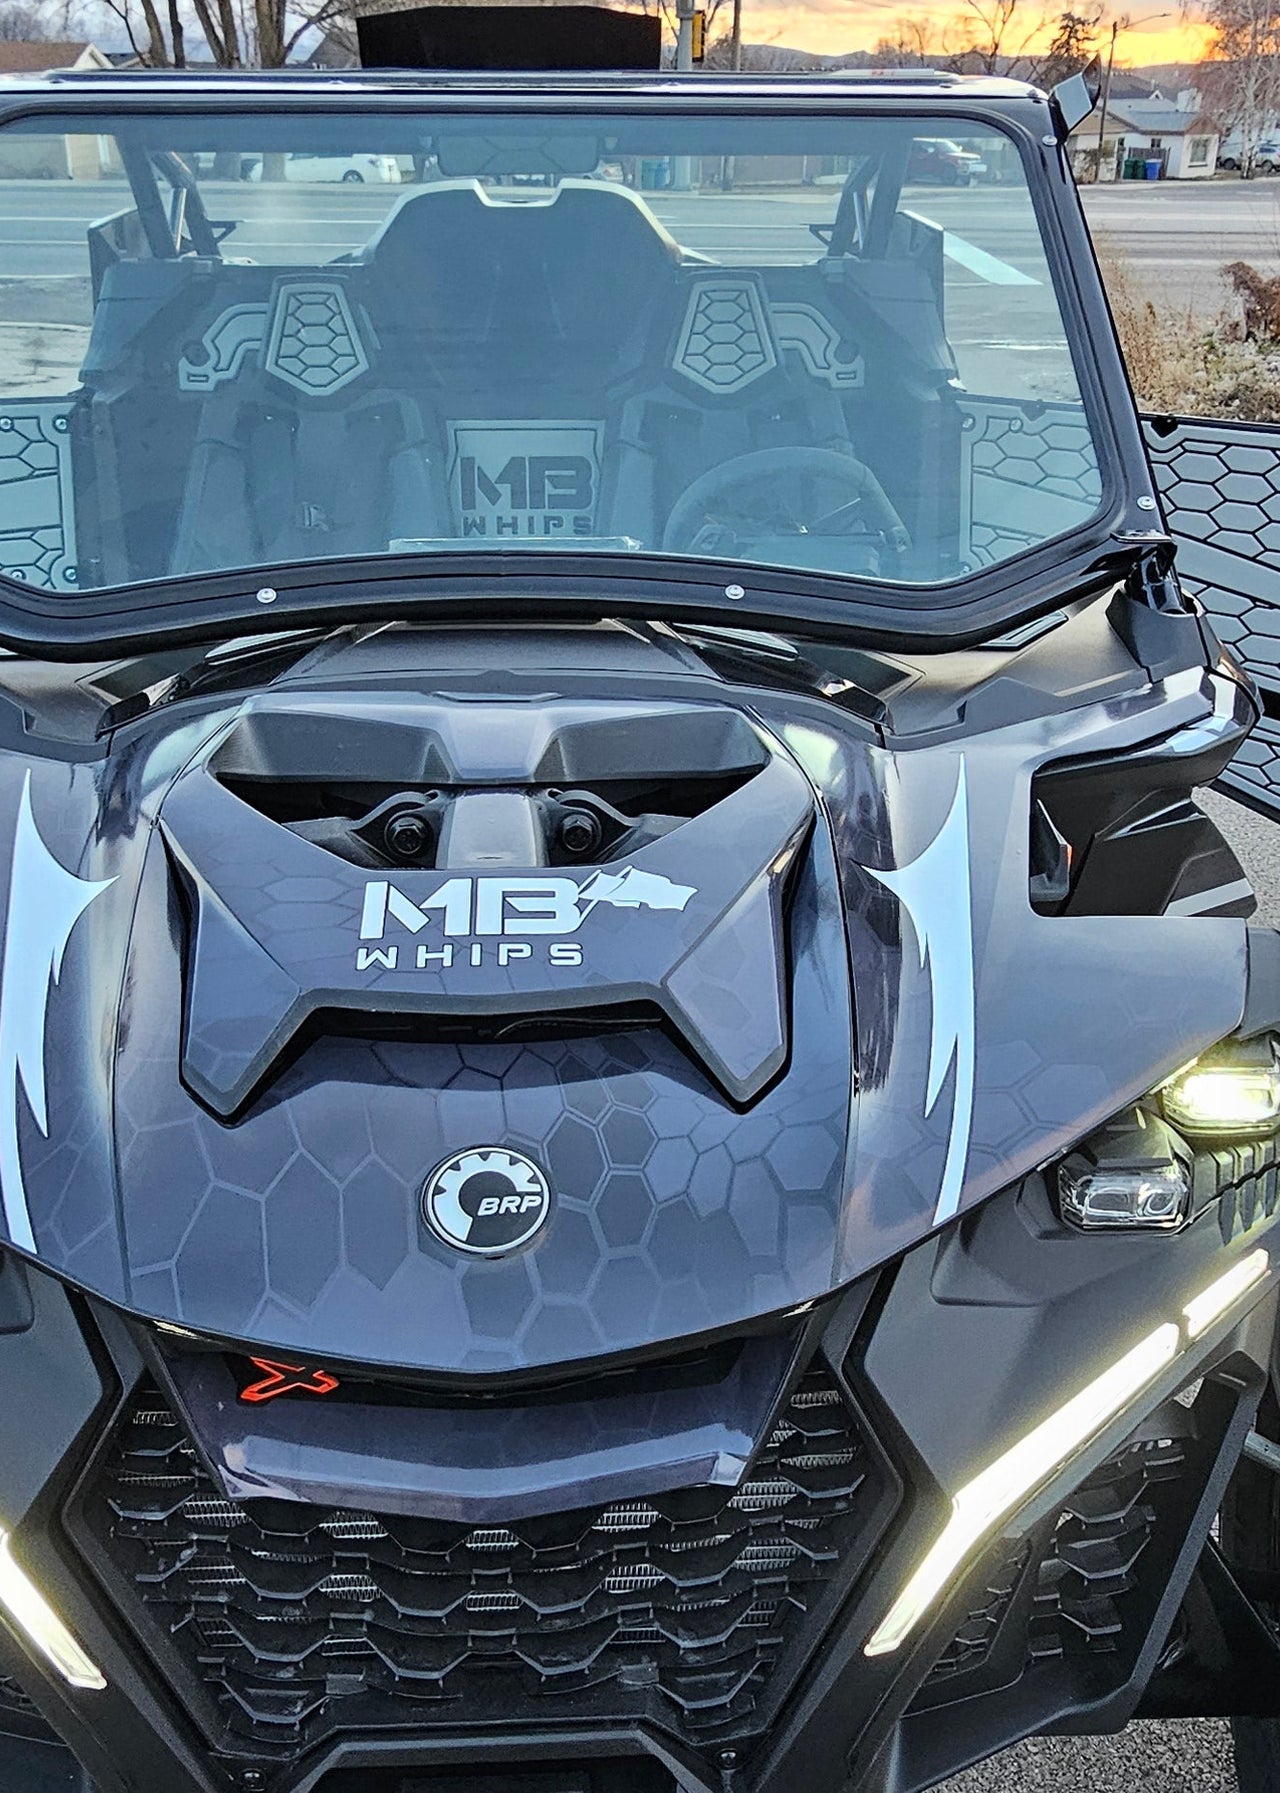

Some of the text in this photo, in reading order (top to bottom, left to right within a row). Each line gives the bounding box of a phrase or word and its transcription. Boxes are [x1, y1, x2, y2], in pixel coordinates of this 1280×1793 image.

[460, 455, 593, 511] MB
[463, 515, 593, 536] WHIPS
[358, 876, 583, 940] MB
[355, 943, 584, 971] WHIPS
[477, 1194, 542, 1216] BRP
